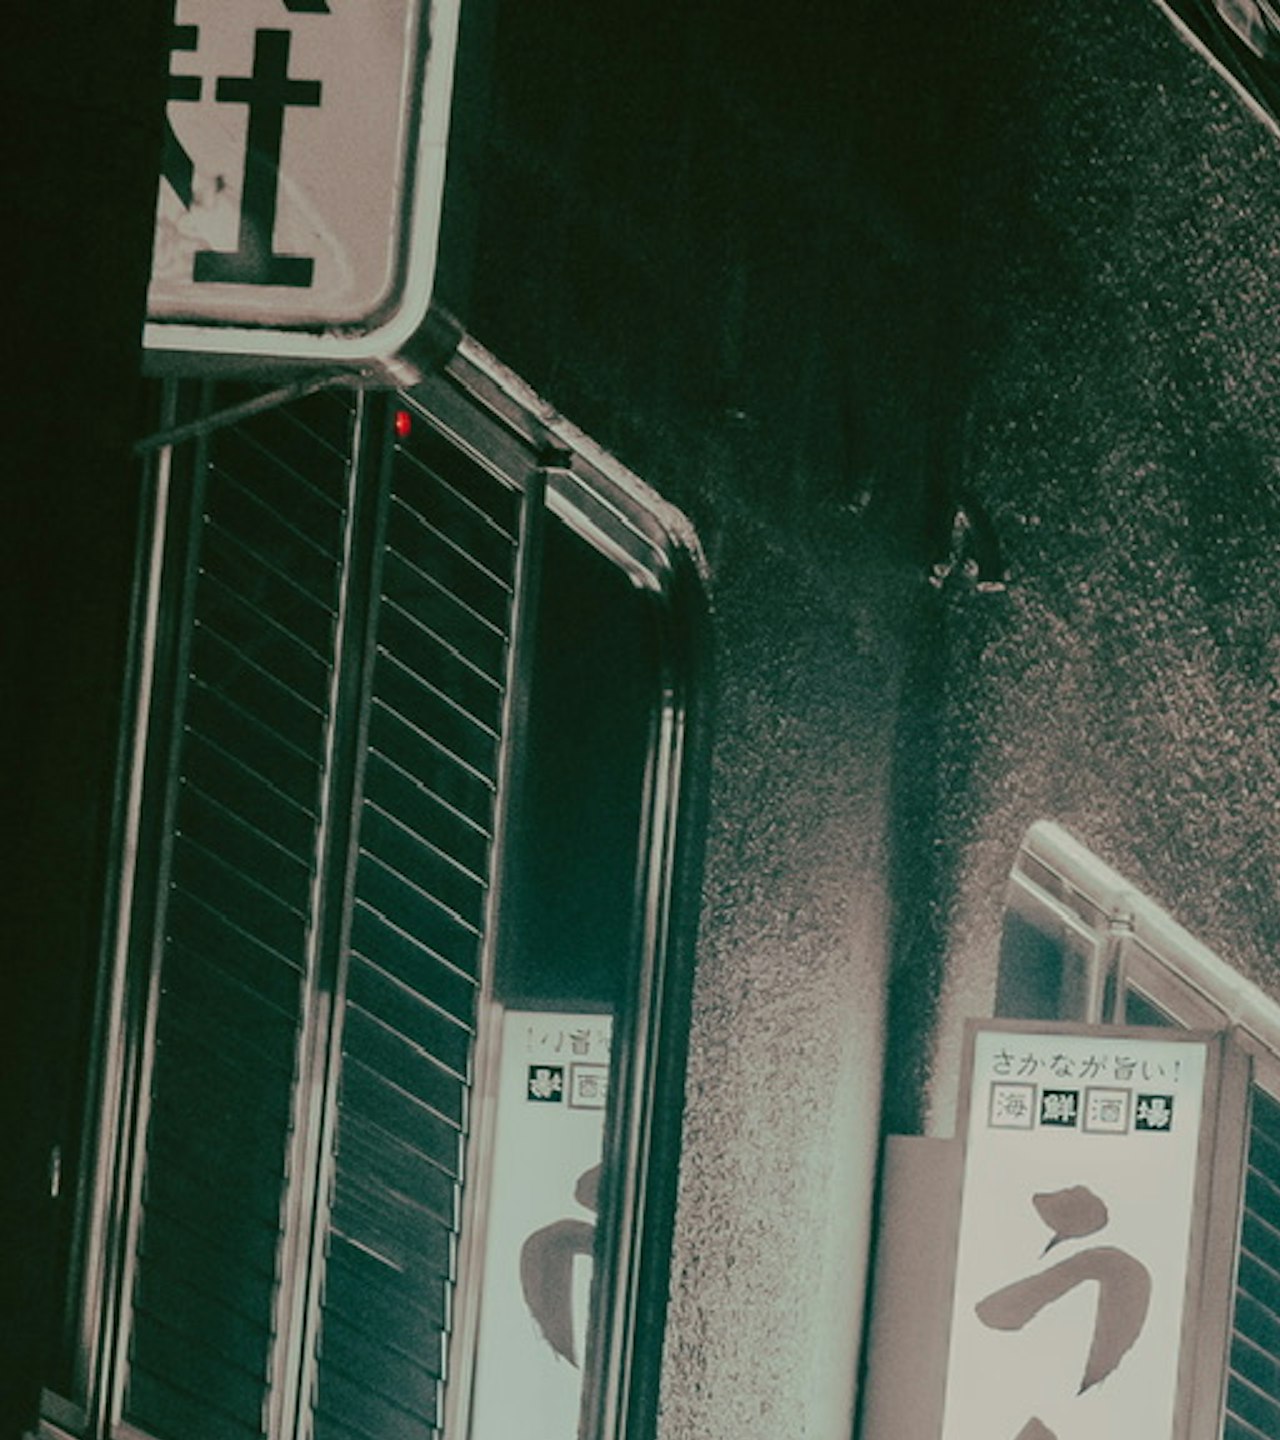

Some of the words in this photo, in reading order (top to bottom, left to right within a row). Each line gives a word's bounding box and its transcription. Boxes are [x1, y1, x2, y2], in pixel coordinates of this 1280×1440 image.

[163, 0, 330, 288] 社
[989, 1083, 1174, 1134] 海鮮酒場
